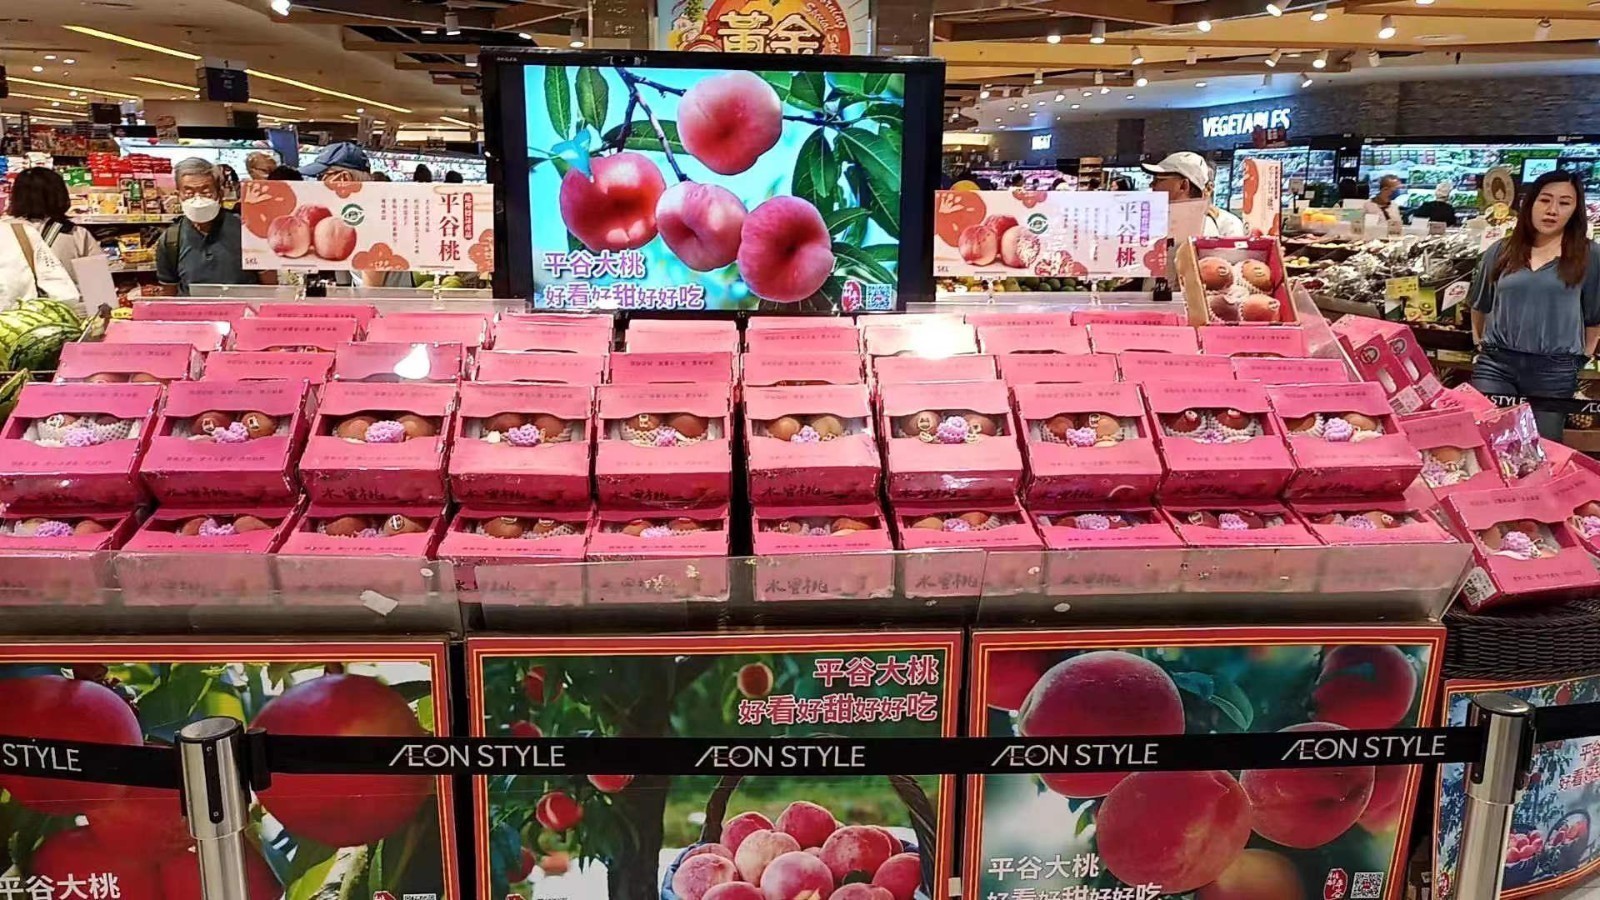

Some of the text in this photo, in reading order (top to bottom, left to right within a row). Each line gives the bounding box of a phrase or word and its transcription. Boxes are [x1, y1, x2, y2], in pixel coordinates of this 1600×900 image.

[1202, 108, 1291, 137] VEGETABLES
[438, 192, 460, 262] 平谷桃
[1115, 201, 1137, 269] 平谷桃
[543, 250, 646, 278] 平谷大桃
[544, 282, 706, 309] 好看好甜好好吃
[813, 655, 939, 687] 平谷大桃
[738, 692, 938, 725] 好看好甜好好吃
[3, 743, 82, 772] STYLE
[477, 744, 566, 768] STYLE
[780, 745, 866, 768] STYLE
[1074, 743, 1159, 766] STYLE
[1363, 735, 1447, 759] STYLE
[988, 853, 1100, 881] 平谷大桃
[0, 872, 121, 900] 平谷大桃
